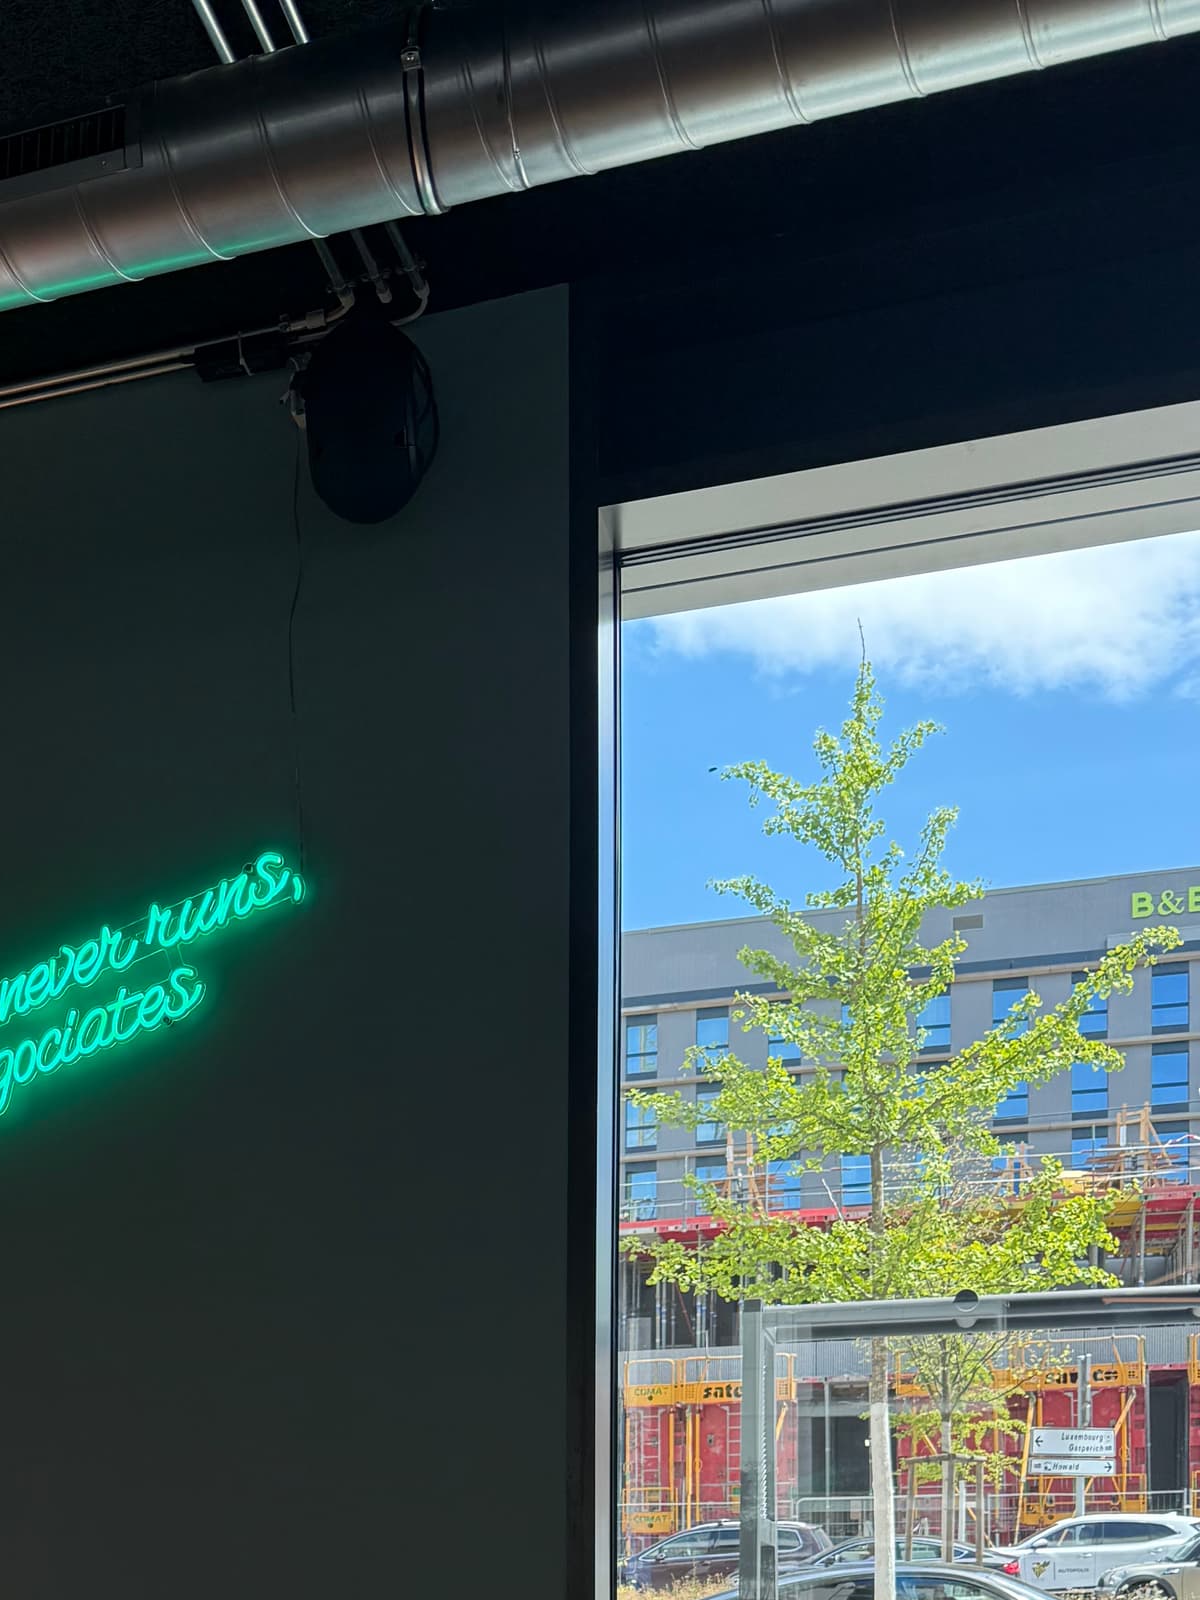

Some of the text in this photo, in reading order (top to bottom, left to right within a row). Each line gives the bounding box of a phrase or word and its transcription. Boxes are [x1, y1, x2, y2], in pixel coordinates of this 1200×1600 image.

[0, 926, 139, 1020] never
[146, 852, 303, 947] runs,
[1061, 1432, 1104, 1443] Luxembourg
[1052, 1462, 1080, 1471] Howald
